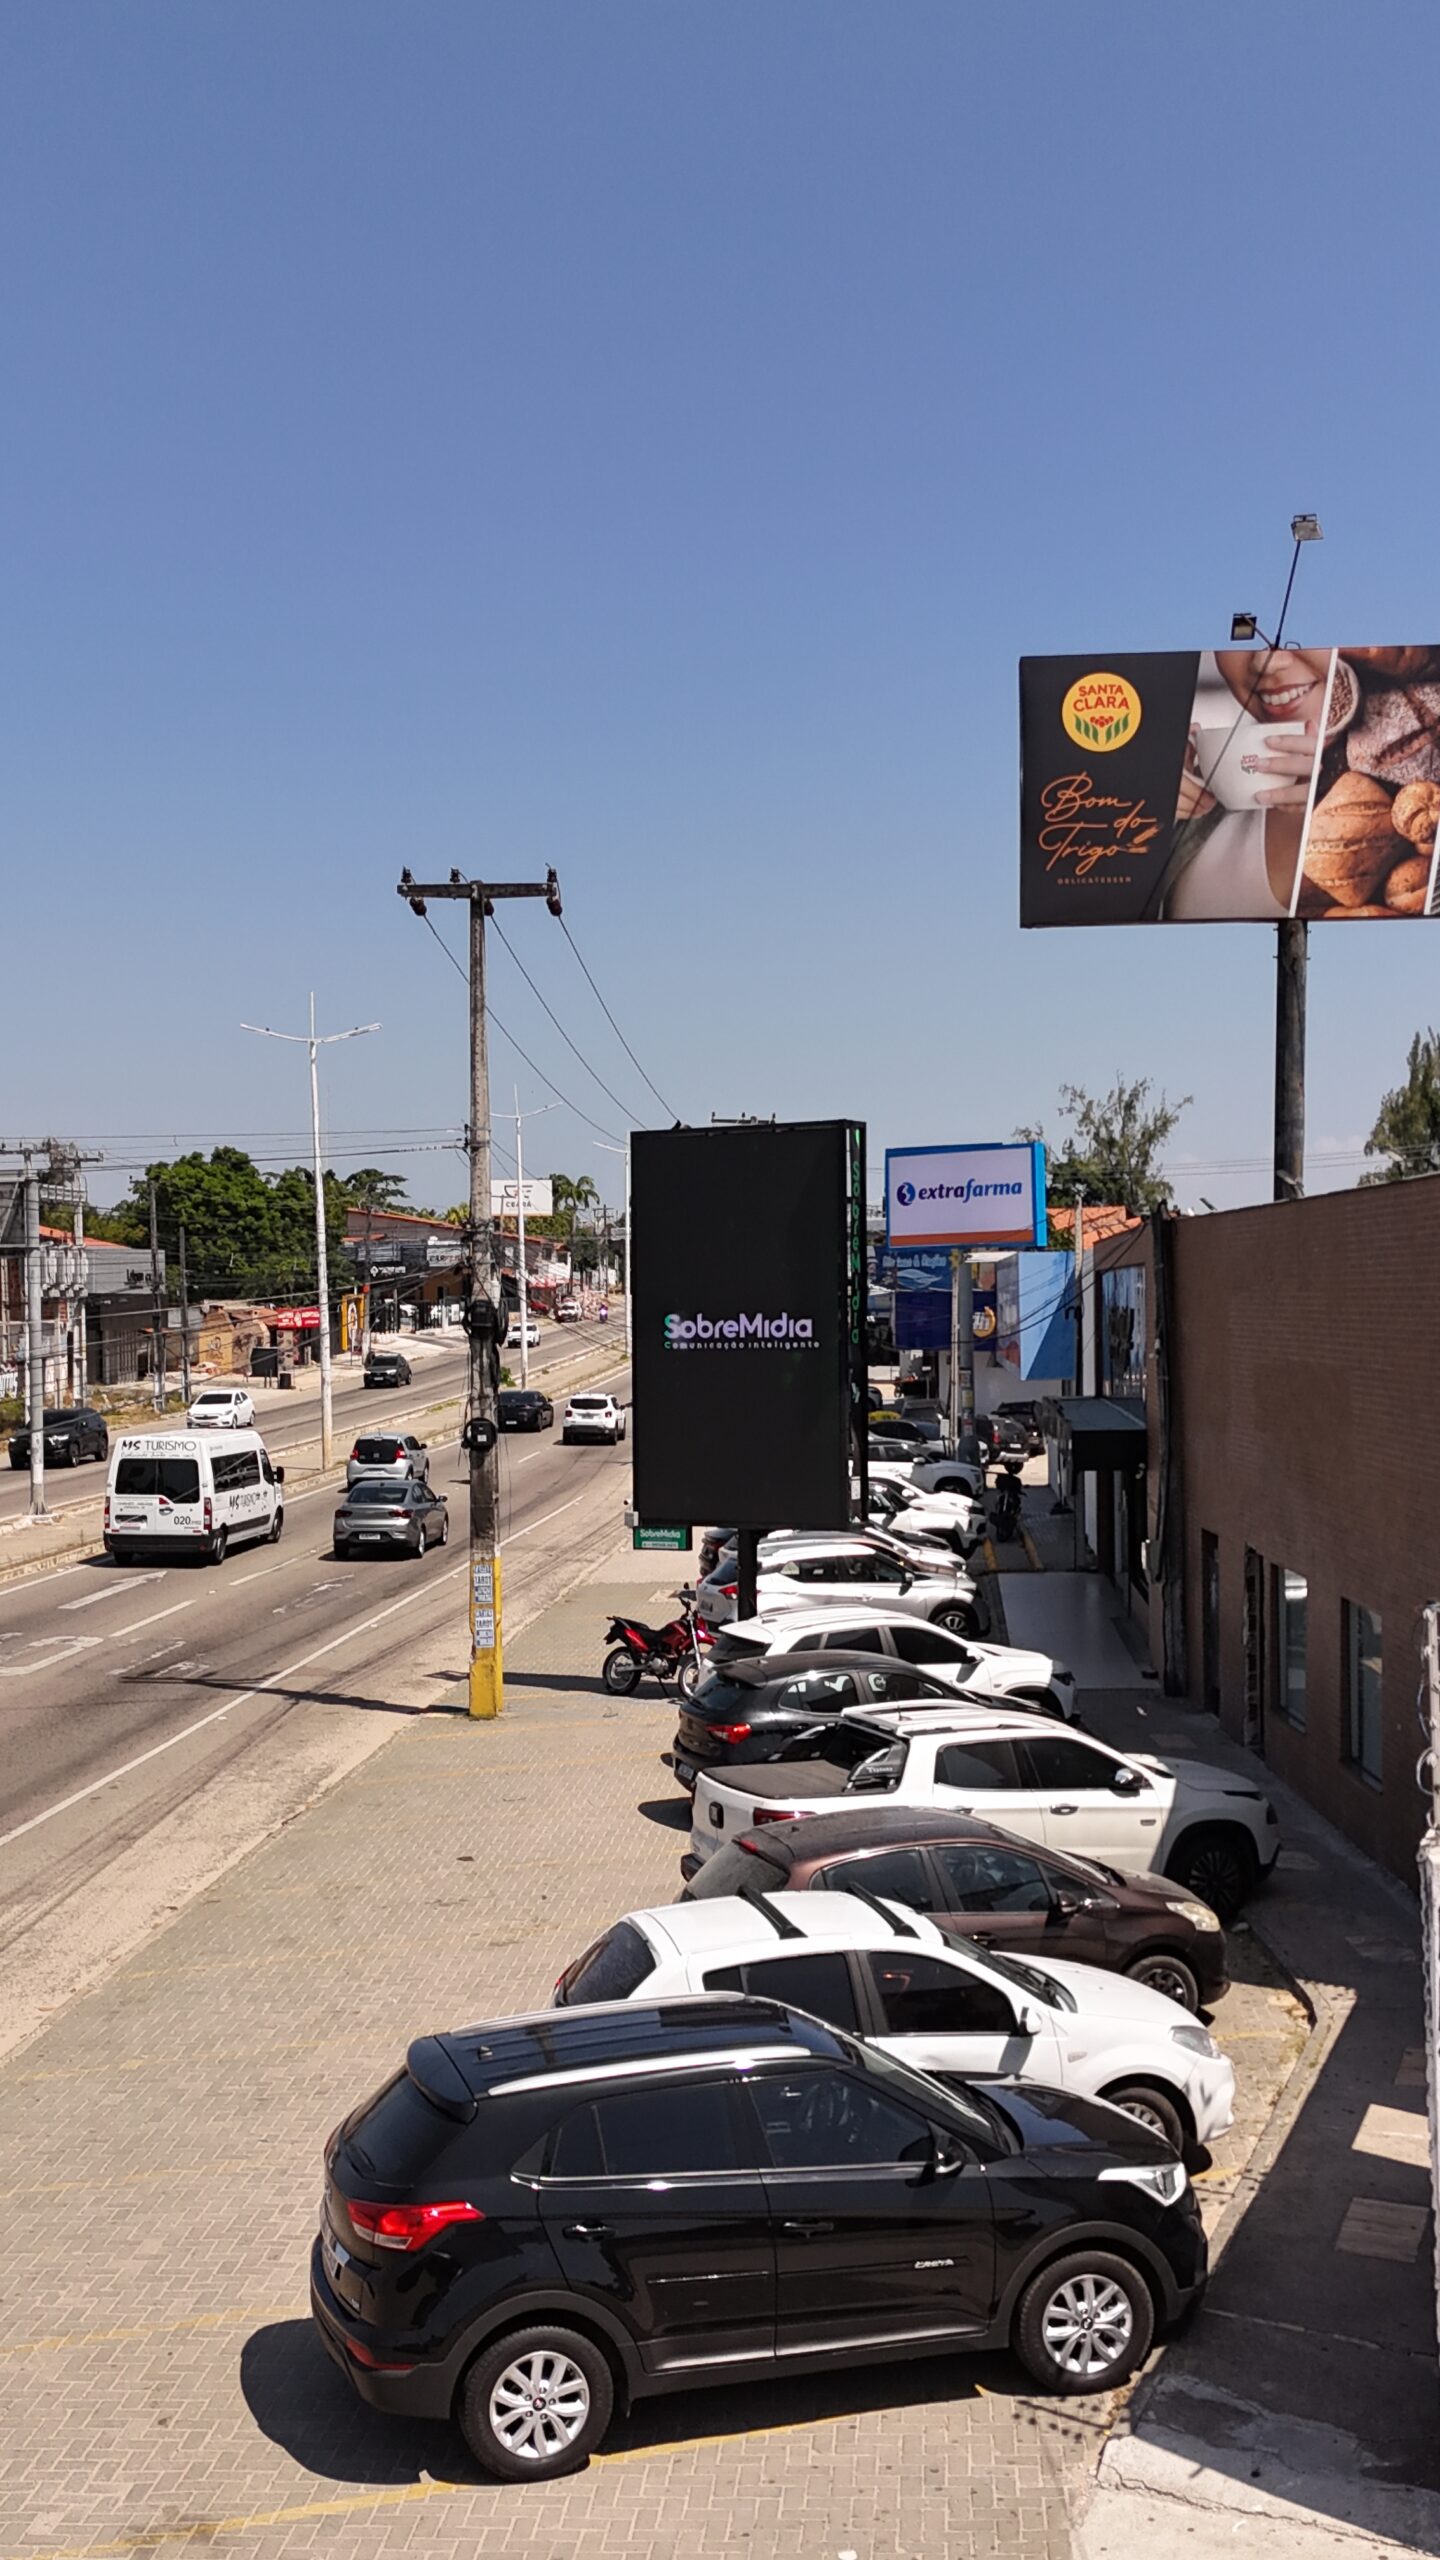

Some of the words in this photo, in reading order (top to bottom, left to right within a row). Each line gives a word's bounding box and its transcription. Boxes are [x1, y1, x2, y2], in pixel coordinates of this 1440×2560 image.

[1078, 684, 1124, 697] SANTA
[1073, 695, 1130, 712] CLARA
[1041, 772, 1132, 821] Bom
[1113, 798, 1157, 839] do
[1038, 821, 1121, 876] Trigo
[1056, 876, 1132, 885] DELICATESSEN
[918, 1178, 1022, 1203] extrafarma
[121, 1440, 142, 1451] MS
[145, 1440, 197, 1451] TURISMO
[173, 1515, 191, 1525] 020
